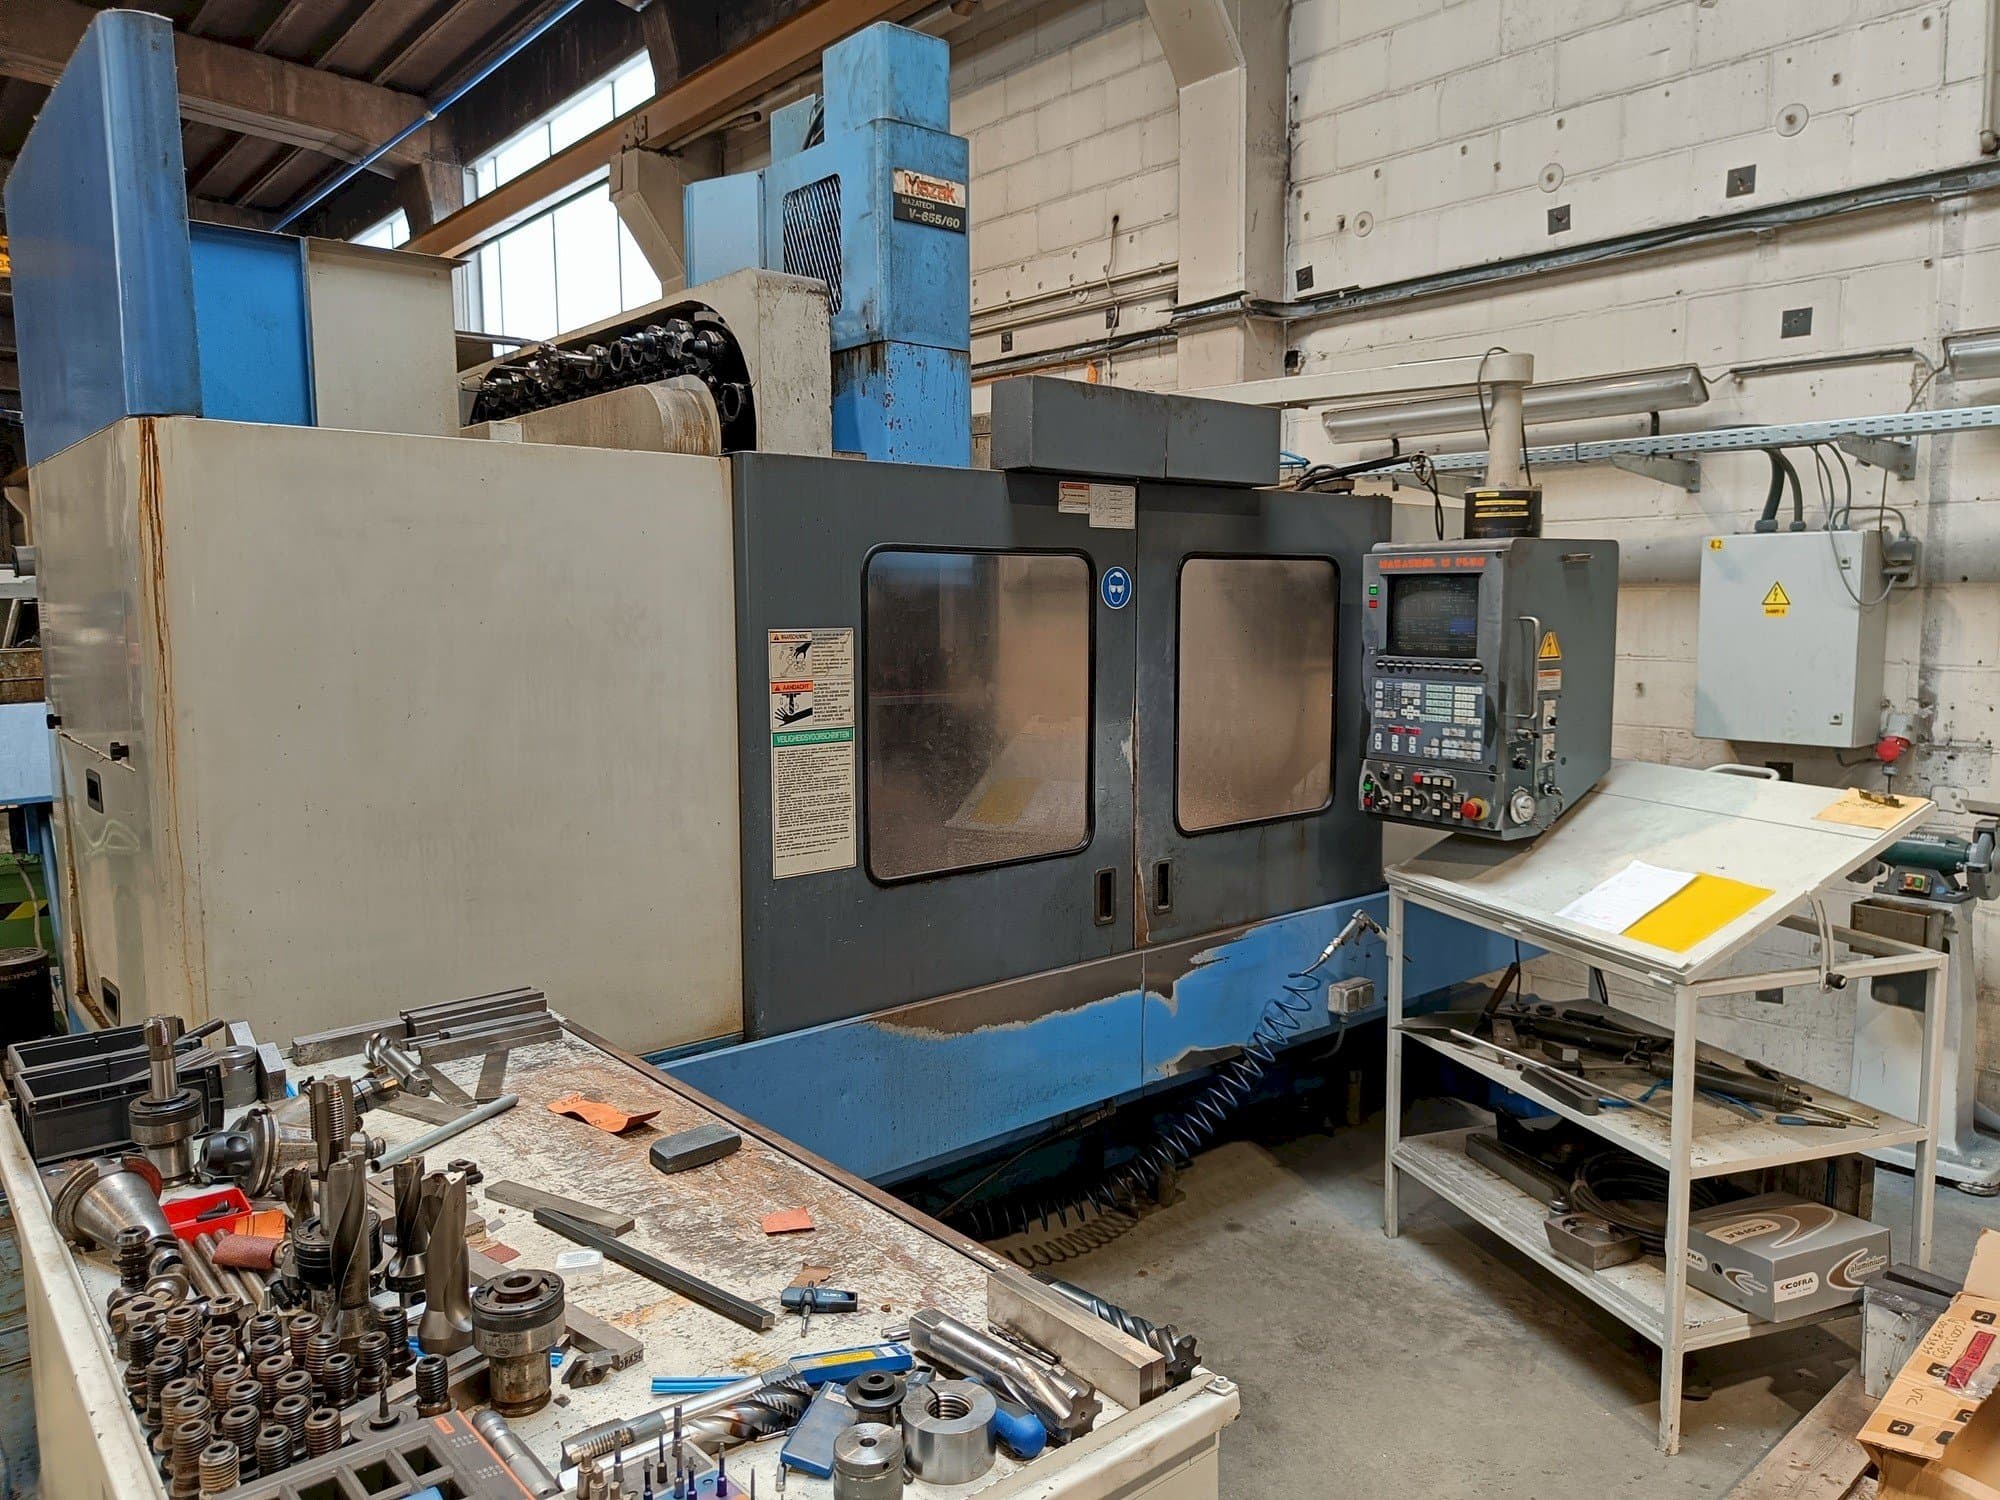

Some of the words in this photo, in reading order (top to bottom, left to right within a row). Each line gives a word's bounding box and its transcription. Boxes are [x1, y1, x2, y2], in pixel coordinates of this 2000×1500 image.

[901, 196, 935, 210] MAZATECH
[909, 207, 960, 228] V-655/60
[1687, 1252, 1703, 1263] FRA
[1785, 1277, 1814, 1290] COFRA
